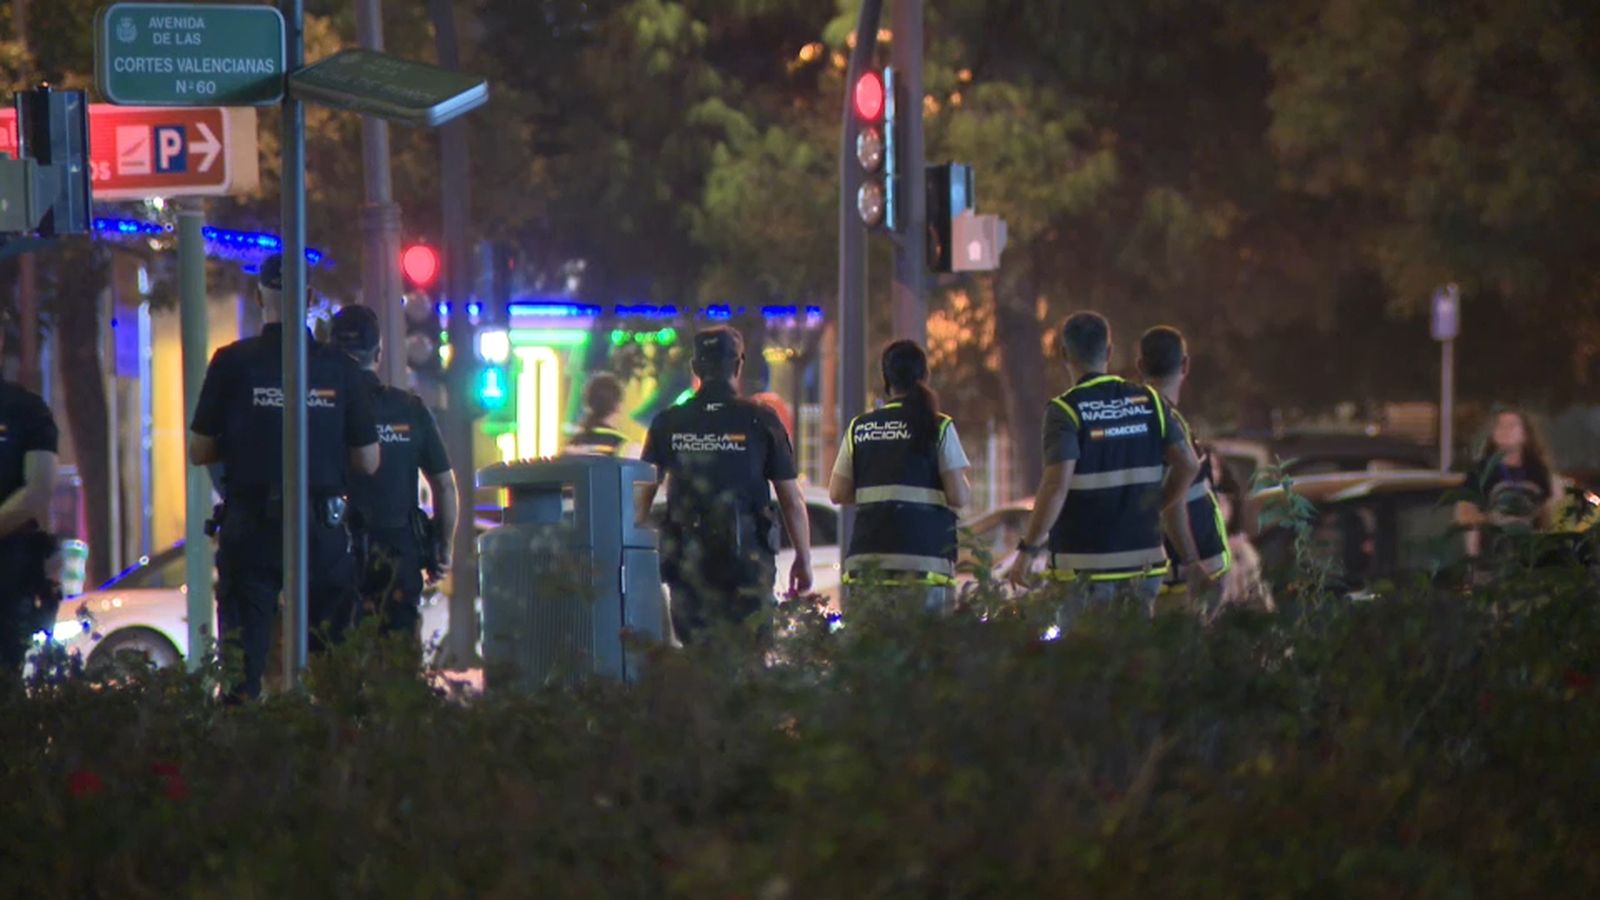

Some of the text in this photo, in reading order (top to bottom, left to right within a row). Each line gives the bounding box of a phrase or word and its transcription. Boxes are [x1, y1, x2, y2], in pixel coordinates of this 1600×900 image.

[148, 16, 206, 30] AVENIDA
[153, 32, 202, 46] DE LAS
[114, 56, 275, 74] CORTES VALENCIANAS
[158, 127, 182, 170] P
[1081, 405, 1153, 420] NACIONAL
[854, 420, 908, 434] POLICI
[671, 433, 731, 443] POLICIA
[671, 442, 747, 452] NACIONAL
